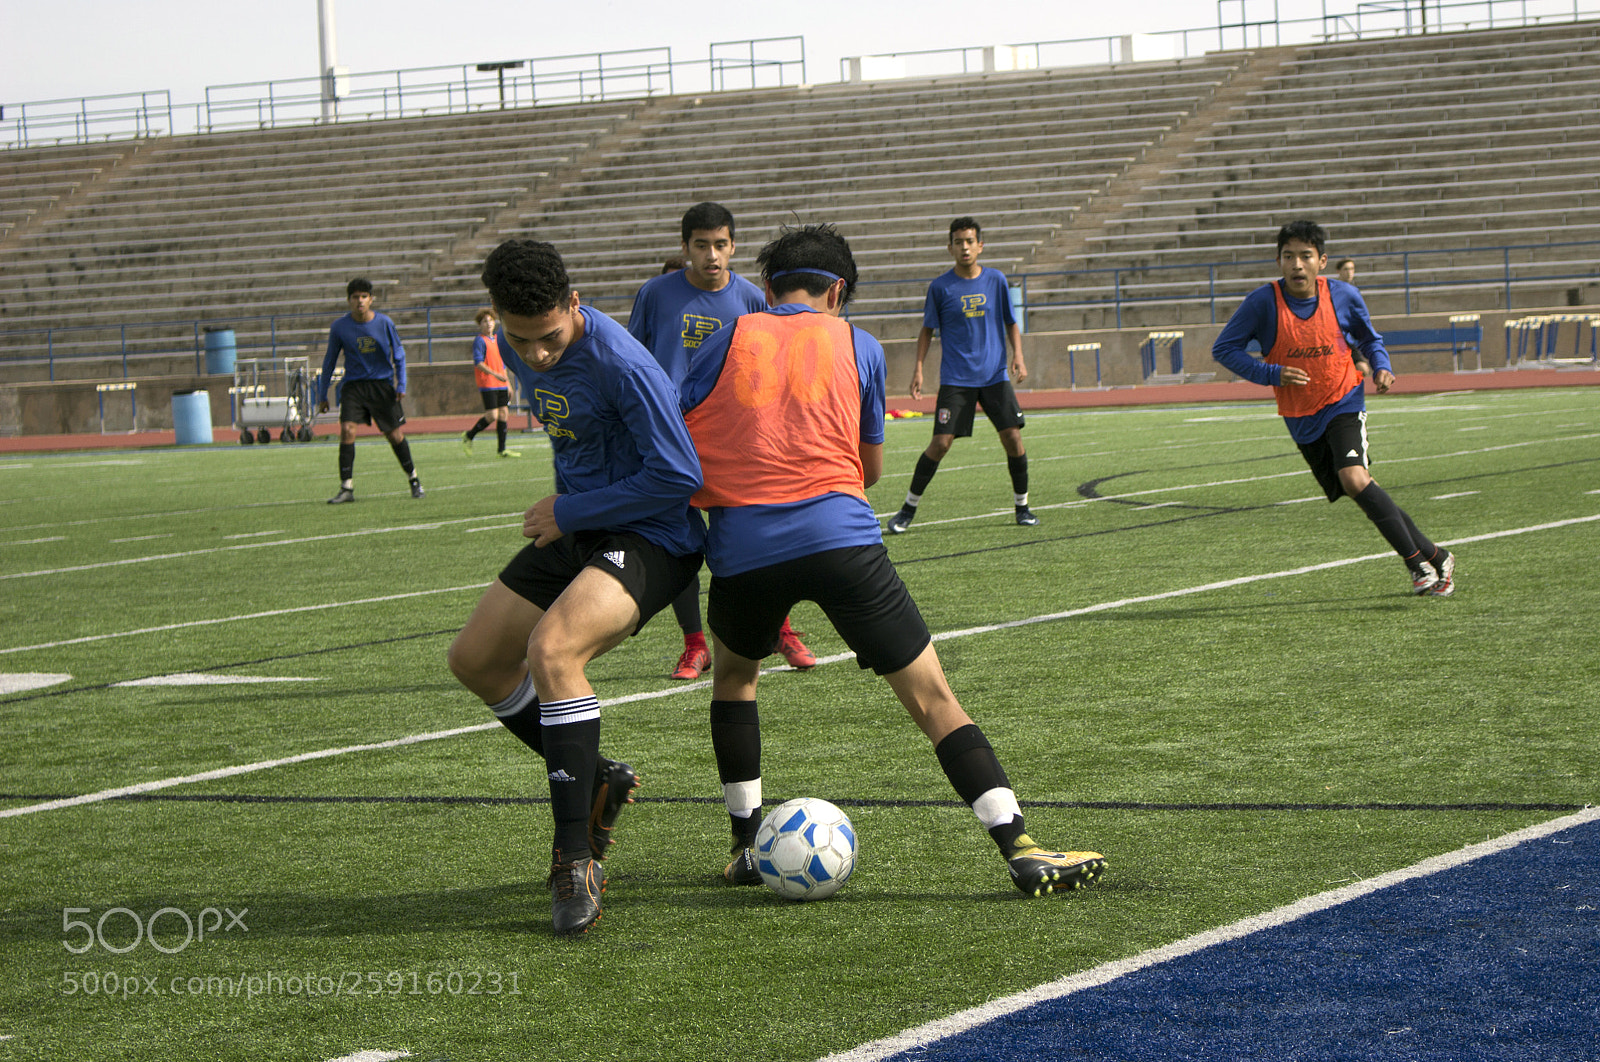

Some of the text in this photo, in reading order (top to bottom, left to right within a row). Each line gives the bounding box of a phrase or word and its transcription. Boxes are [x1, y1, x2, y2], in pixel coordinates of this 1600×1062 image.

[960, 293, 987, 313] P
[681, 313, 723, 340] P
[534, 388, 570, 426] P
